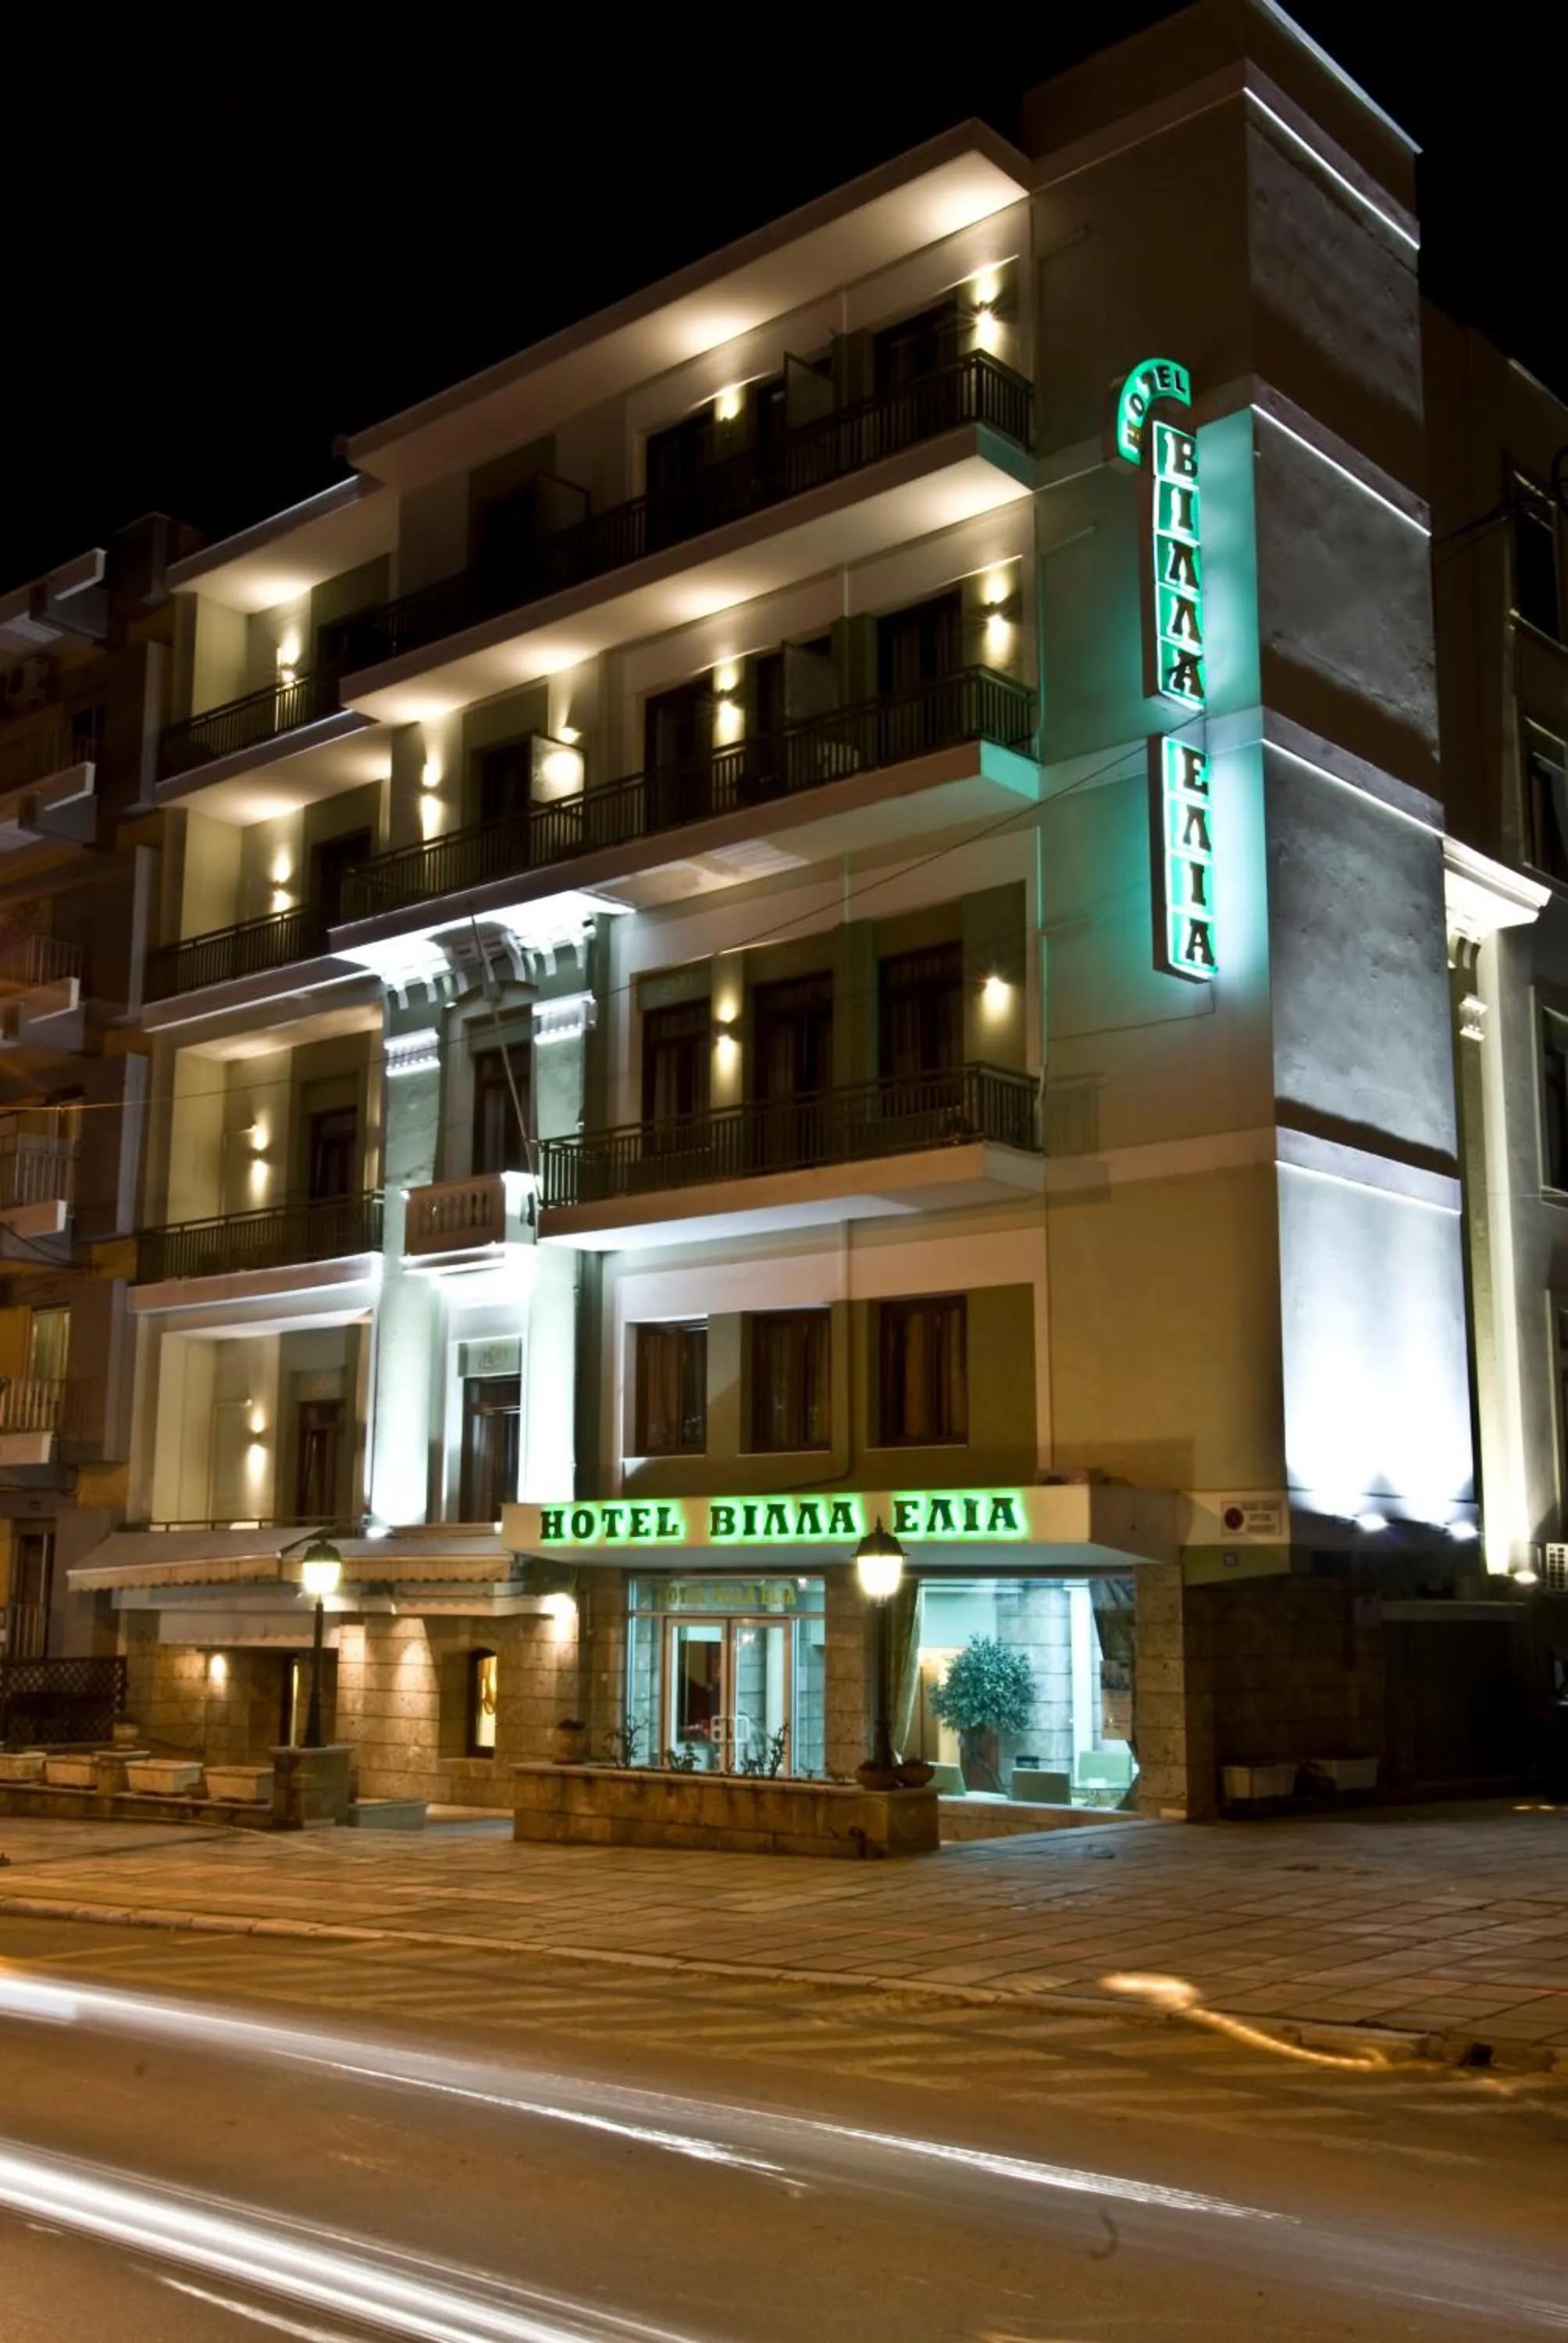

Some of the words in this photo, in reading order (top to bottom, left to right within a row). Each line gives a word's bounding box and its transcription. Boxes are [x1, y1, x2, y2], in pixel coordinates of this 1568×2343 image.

[1122, 364, 1188, 454] HOTEL
[540, 1506, 680, 1540] HOTEL
[710, 1501, 857, 1537] ΒΙΛΛΑ
[893, 1496, 1018, 1533] ΕΛΙΑ
